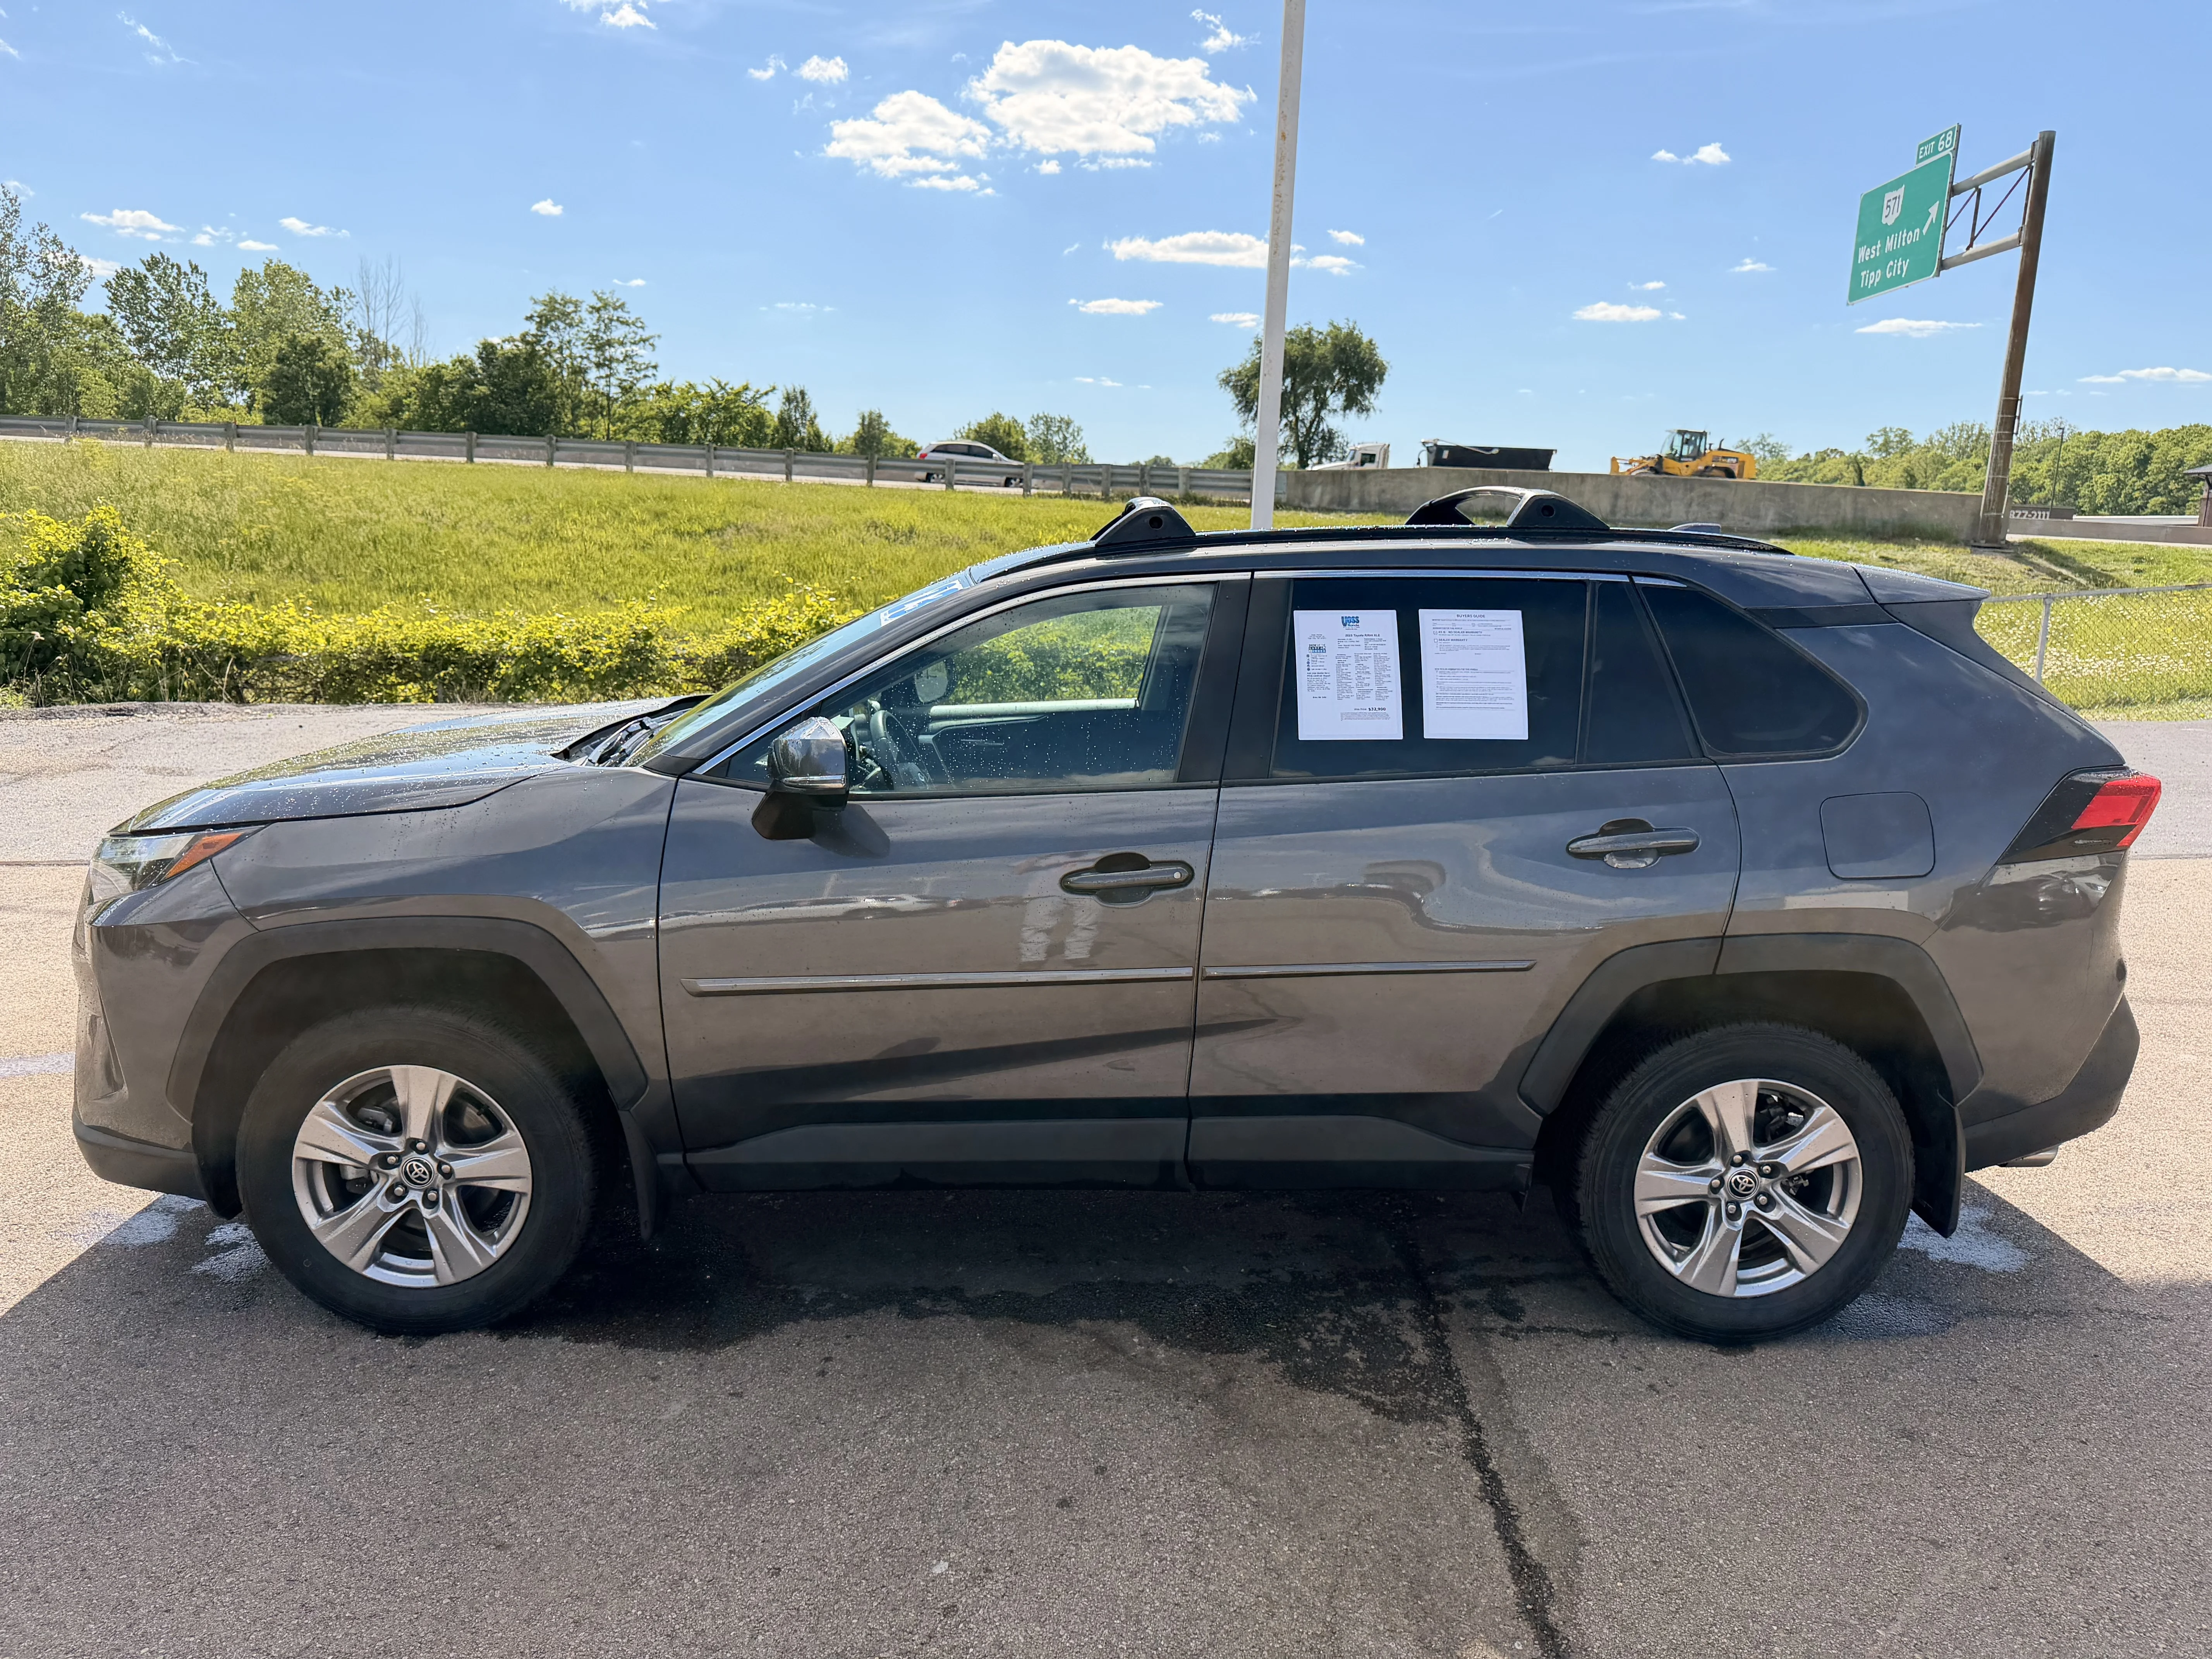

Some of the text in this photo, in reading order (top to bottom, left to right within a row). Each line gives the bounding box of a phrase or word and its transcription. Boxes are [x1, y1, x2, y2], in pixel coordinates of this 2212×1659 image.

[1919, 130, 1953, 159] EXIT 68
[1885, 196, 1900, 218] 571
[1858, 228, 1920, 264] West Milton
[1861, 258, 1910, 288] Tipp City
[1341, 616, 1360, 627] VOSS
